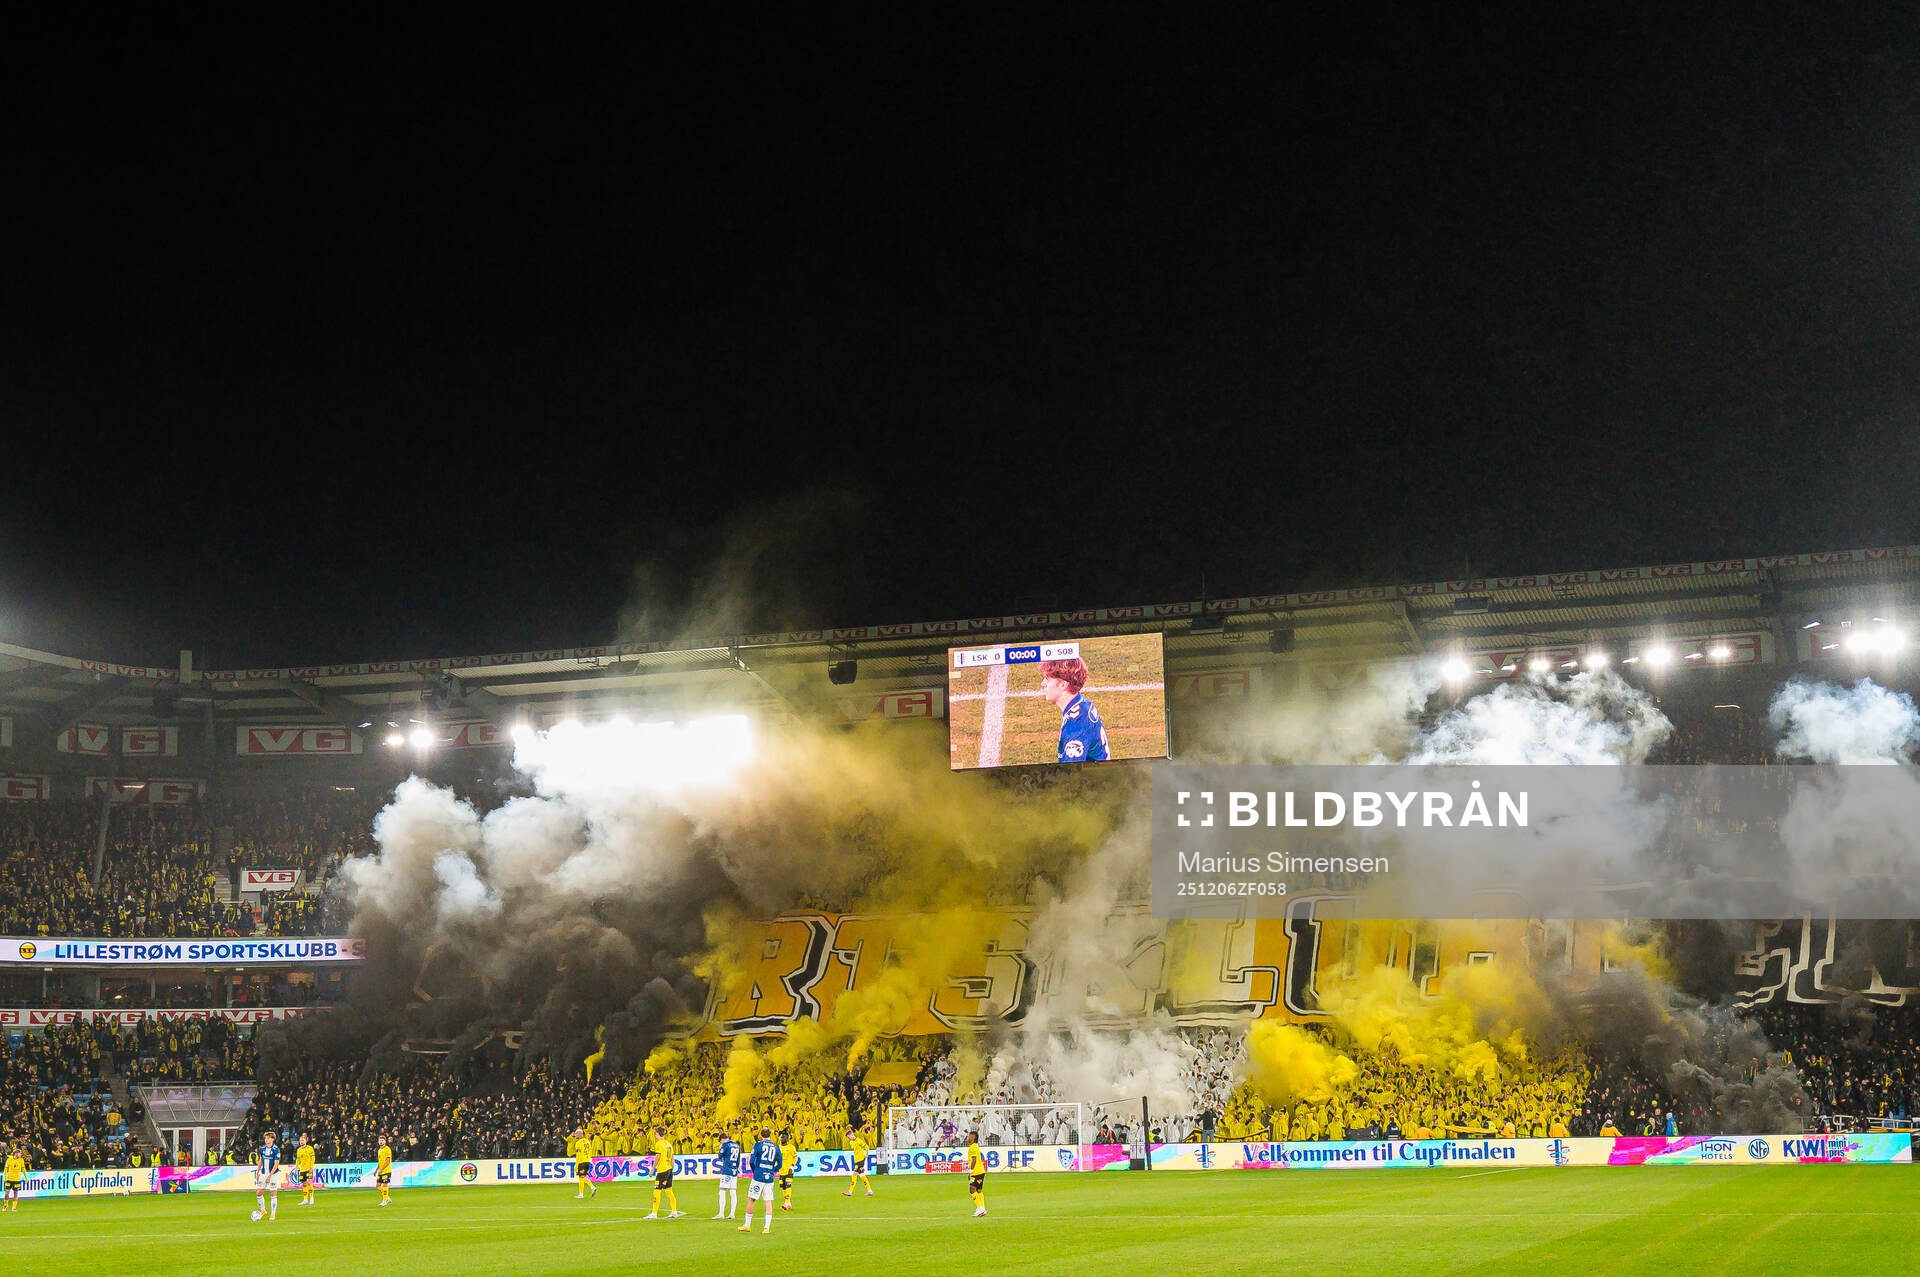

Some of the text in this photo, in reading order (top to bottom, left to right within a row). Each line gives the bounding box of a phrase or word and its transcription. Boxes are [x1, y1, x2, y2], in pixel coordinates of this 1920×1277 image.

[1654, 566, 1690, 576] VG
[1707, 562, 1744, 571] VG
[1550, 574, 1586, 583] VG
[1602, 570, 1639, 580] VG
[1500, 577, 1536, 587] VG
[1155, 604, 1189, 614] VG
[1206, 600, 1239, 610] VG
[1061, 611, 1095, 621] VG
[1108, 608, 1142, 617] VG
[970, 619, 1003, 628] VG
[1015, 615, 1048, 625] VG
[880, 625, 912, 635] VG
[925, 622, 957, 632] VG
[833, 628, 866, 639] VG
[973, 654, 988, 662] LSK
[995, 653, 1001, 661] 0
[1009, 650, 1037, 660] 00:00
[78, 728, 161, 753] VG
[251, 730, 346, 751] VG
[0, 780, 38, 799] G
[97, 781, 194, 804] VG
[250, 872, 293, 883] VG
[55, 943, 182, 961] LILLESTRØM
[188, 943, 338, 959] SPORTSKLUBB
[0, 1012, 16, 1024] G
[33, 1012, 78, 1024] VG
[224, 1011, 268, 1023] VG
[1696, 1139, 1736, 1151] THON
[1828, 1138, 1847, 1148] mini
[761, 1145, 776, 1162] 20
[1243, 1141, 1516, 1167] Velkommen til Cupfinalen
[1783, 1140, 1826, 1158] KIWI
[1828, 1148, 1846, 1159] pris
[1007, 1150, 1035, 1167] FF
[316, 1168, 347, 1184] KIWI
[349, 1166, 363, 1175] mini
[58, 1173, 69, 1189] til
[72, 1171, 133, 1193] Cupfinalen
[349, 1174, 361, 1184] pris
